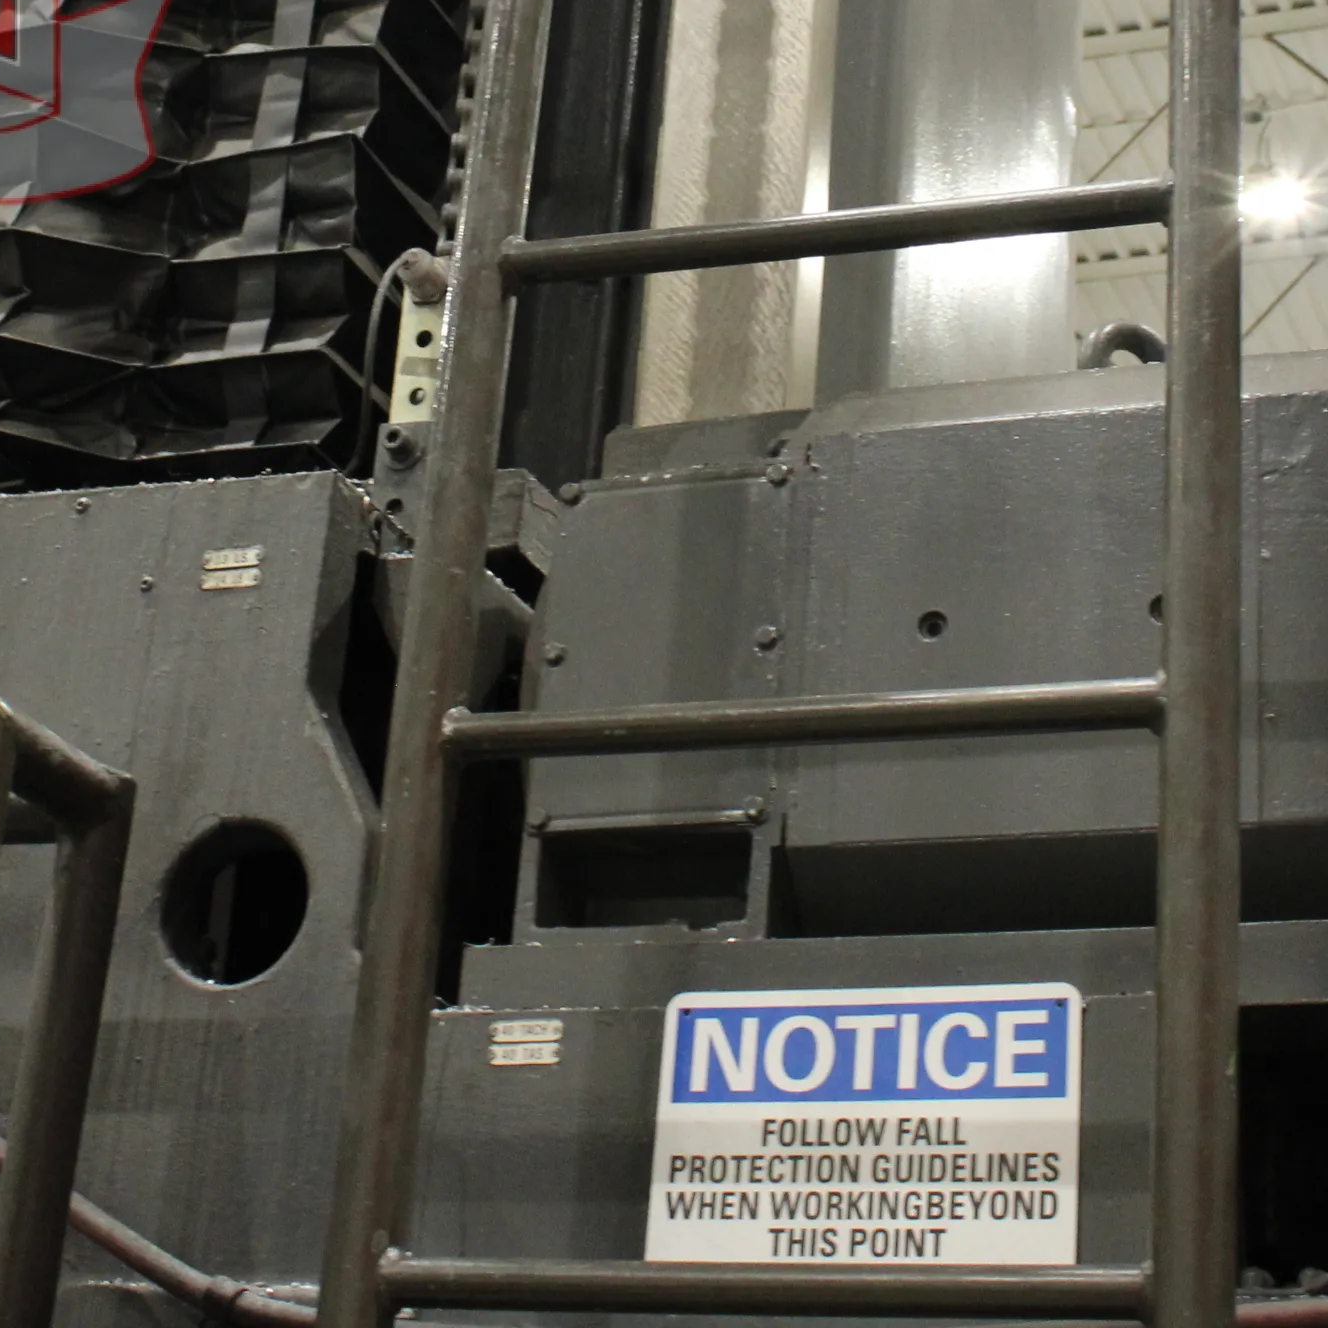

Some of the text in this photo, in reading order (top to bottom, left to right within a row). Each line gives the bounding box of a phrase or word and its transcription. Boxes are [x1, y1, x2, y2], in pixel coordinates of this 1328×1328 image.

[689, 1010, 1049, 1093] NOTICE
[762, 1117, 966, 1147] FOLLOW FALL
[670, 1152, 1059, 1184] PROTECTION GUIDELINES
[666, 1191, 759, 1220] WHEN
[768, 1228, 948, 1258] THIS POINT
